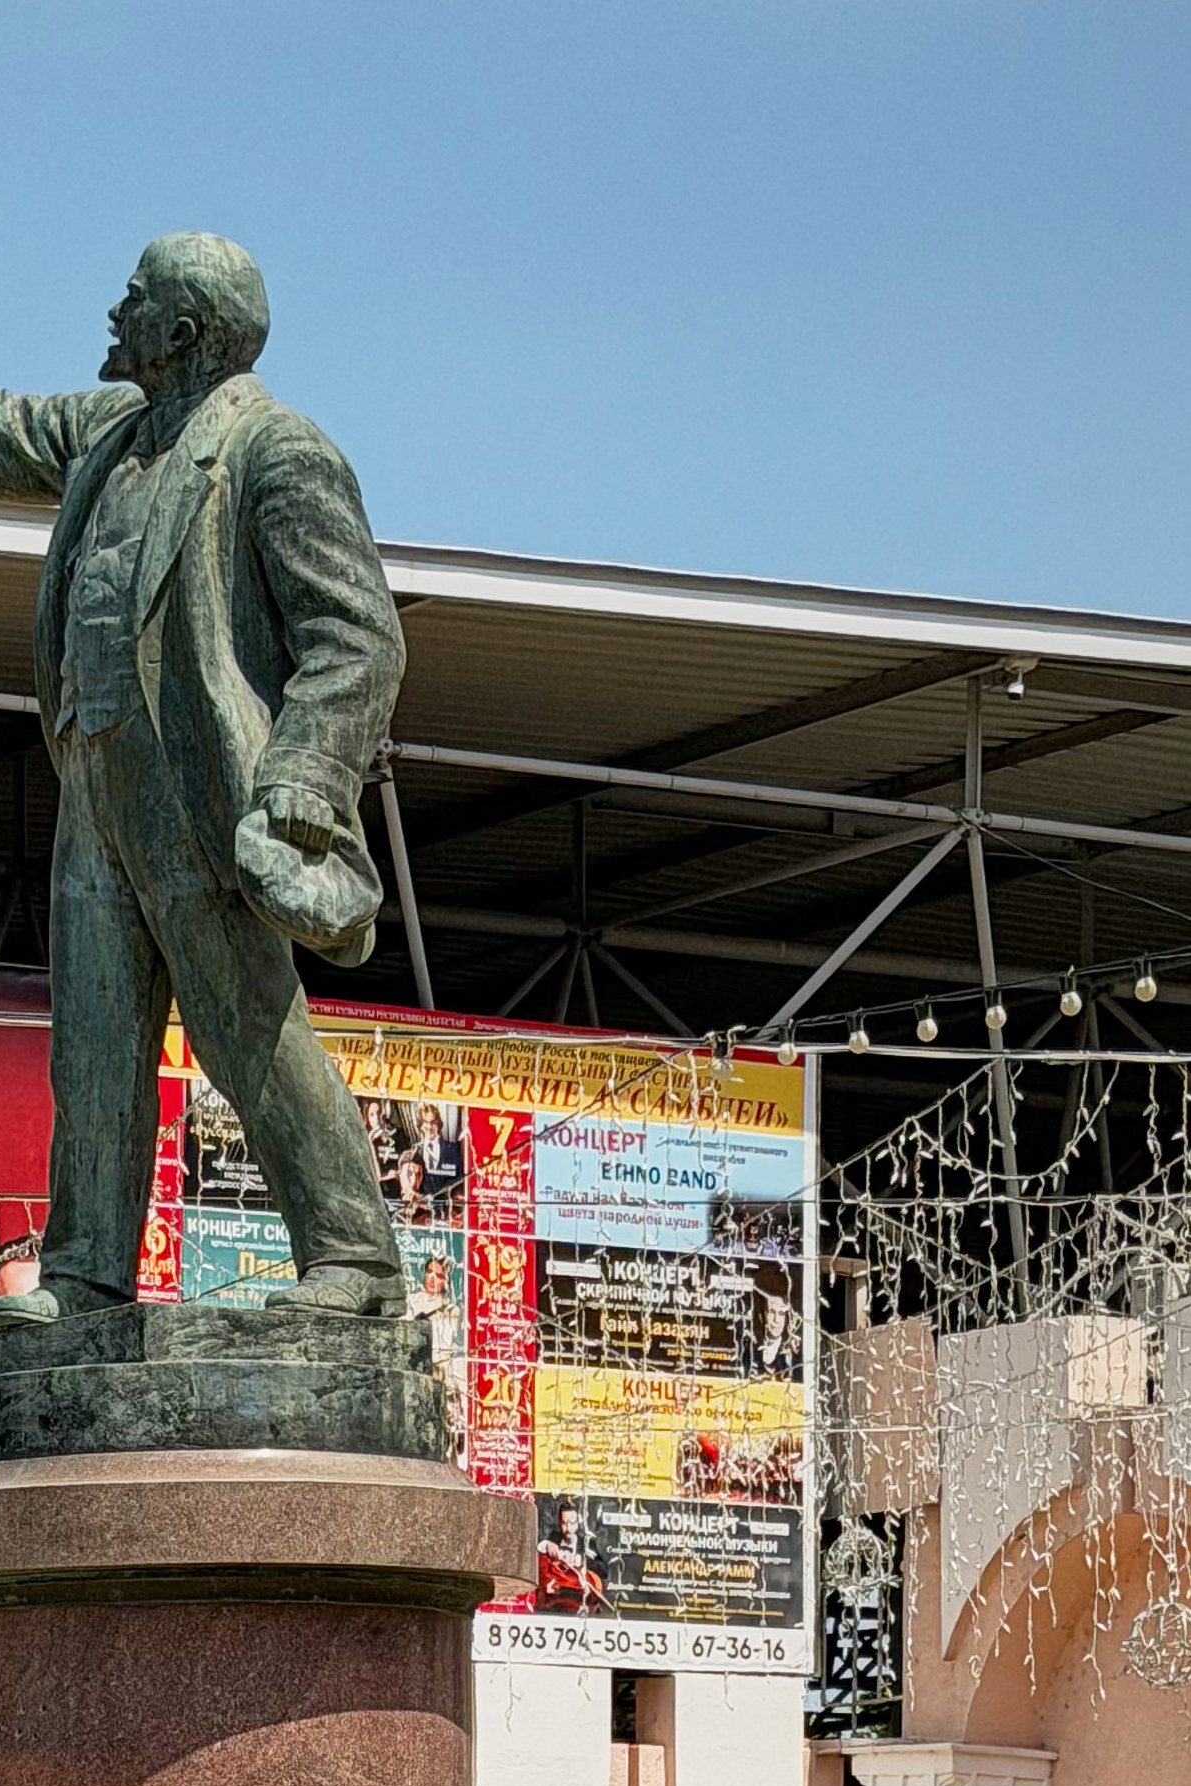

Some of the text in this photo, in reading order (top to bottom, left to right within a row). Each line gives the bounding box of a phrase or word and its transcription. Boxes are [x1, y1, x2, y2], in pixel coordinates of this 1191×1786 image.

[489, 1115, 514, 1156] 7
[541, 1123, 647, 1155] КОНЦЕРТ
[667, 1166, 717, 1190] BAND
[186, 1217, 261, 1240] КОНЦЕРТ
[484, 1244, 519, 1282] 19
[613, 1260, 701, 1287] КОНЦЕРТ
[483, 1373, 520, 1410] 20
[622, 1377, 714, 1404] КОНЦЕРТ
[658, 1512, 740, 1535] КОНЦЕРТ
[488, 1626, 786, 1660] 8 963 794-50-53 67-36-16
